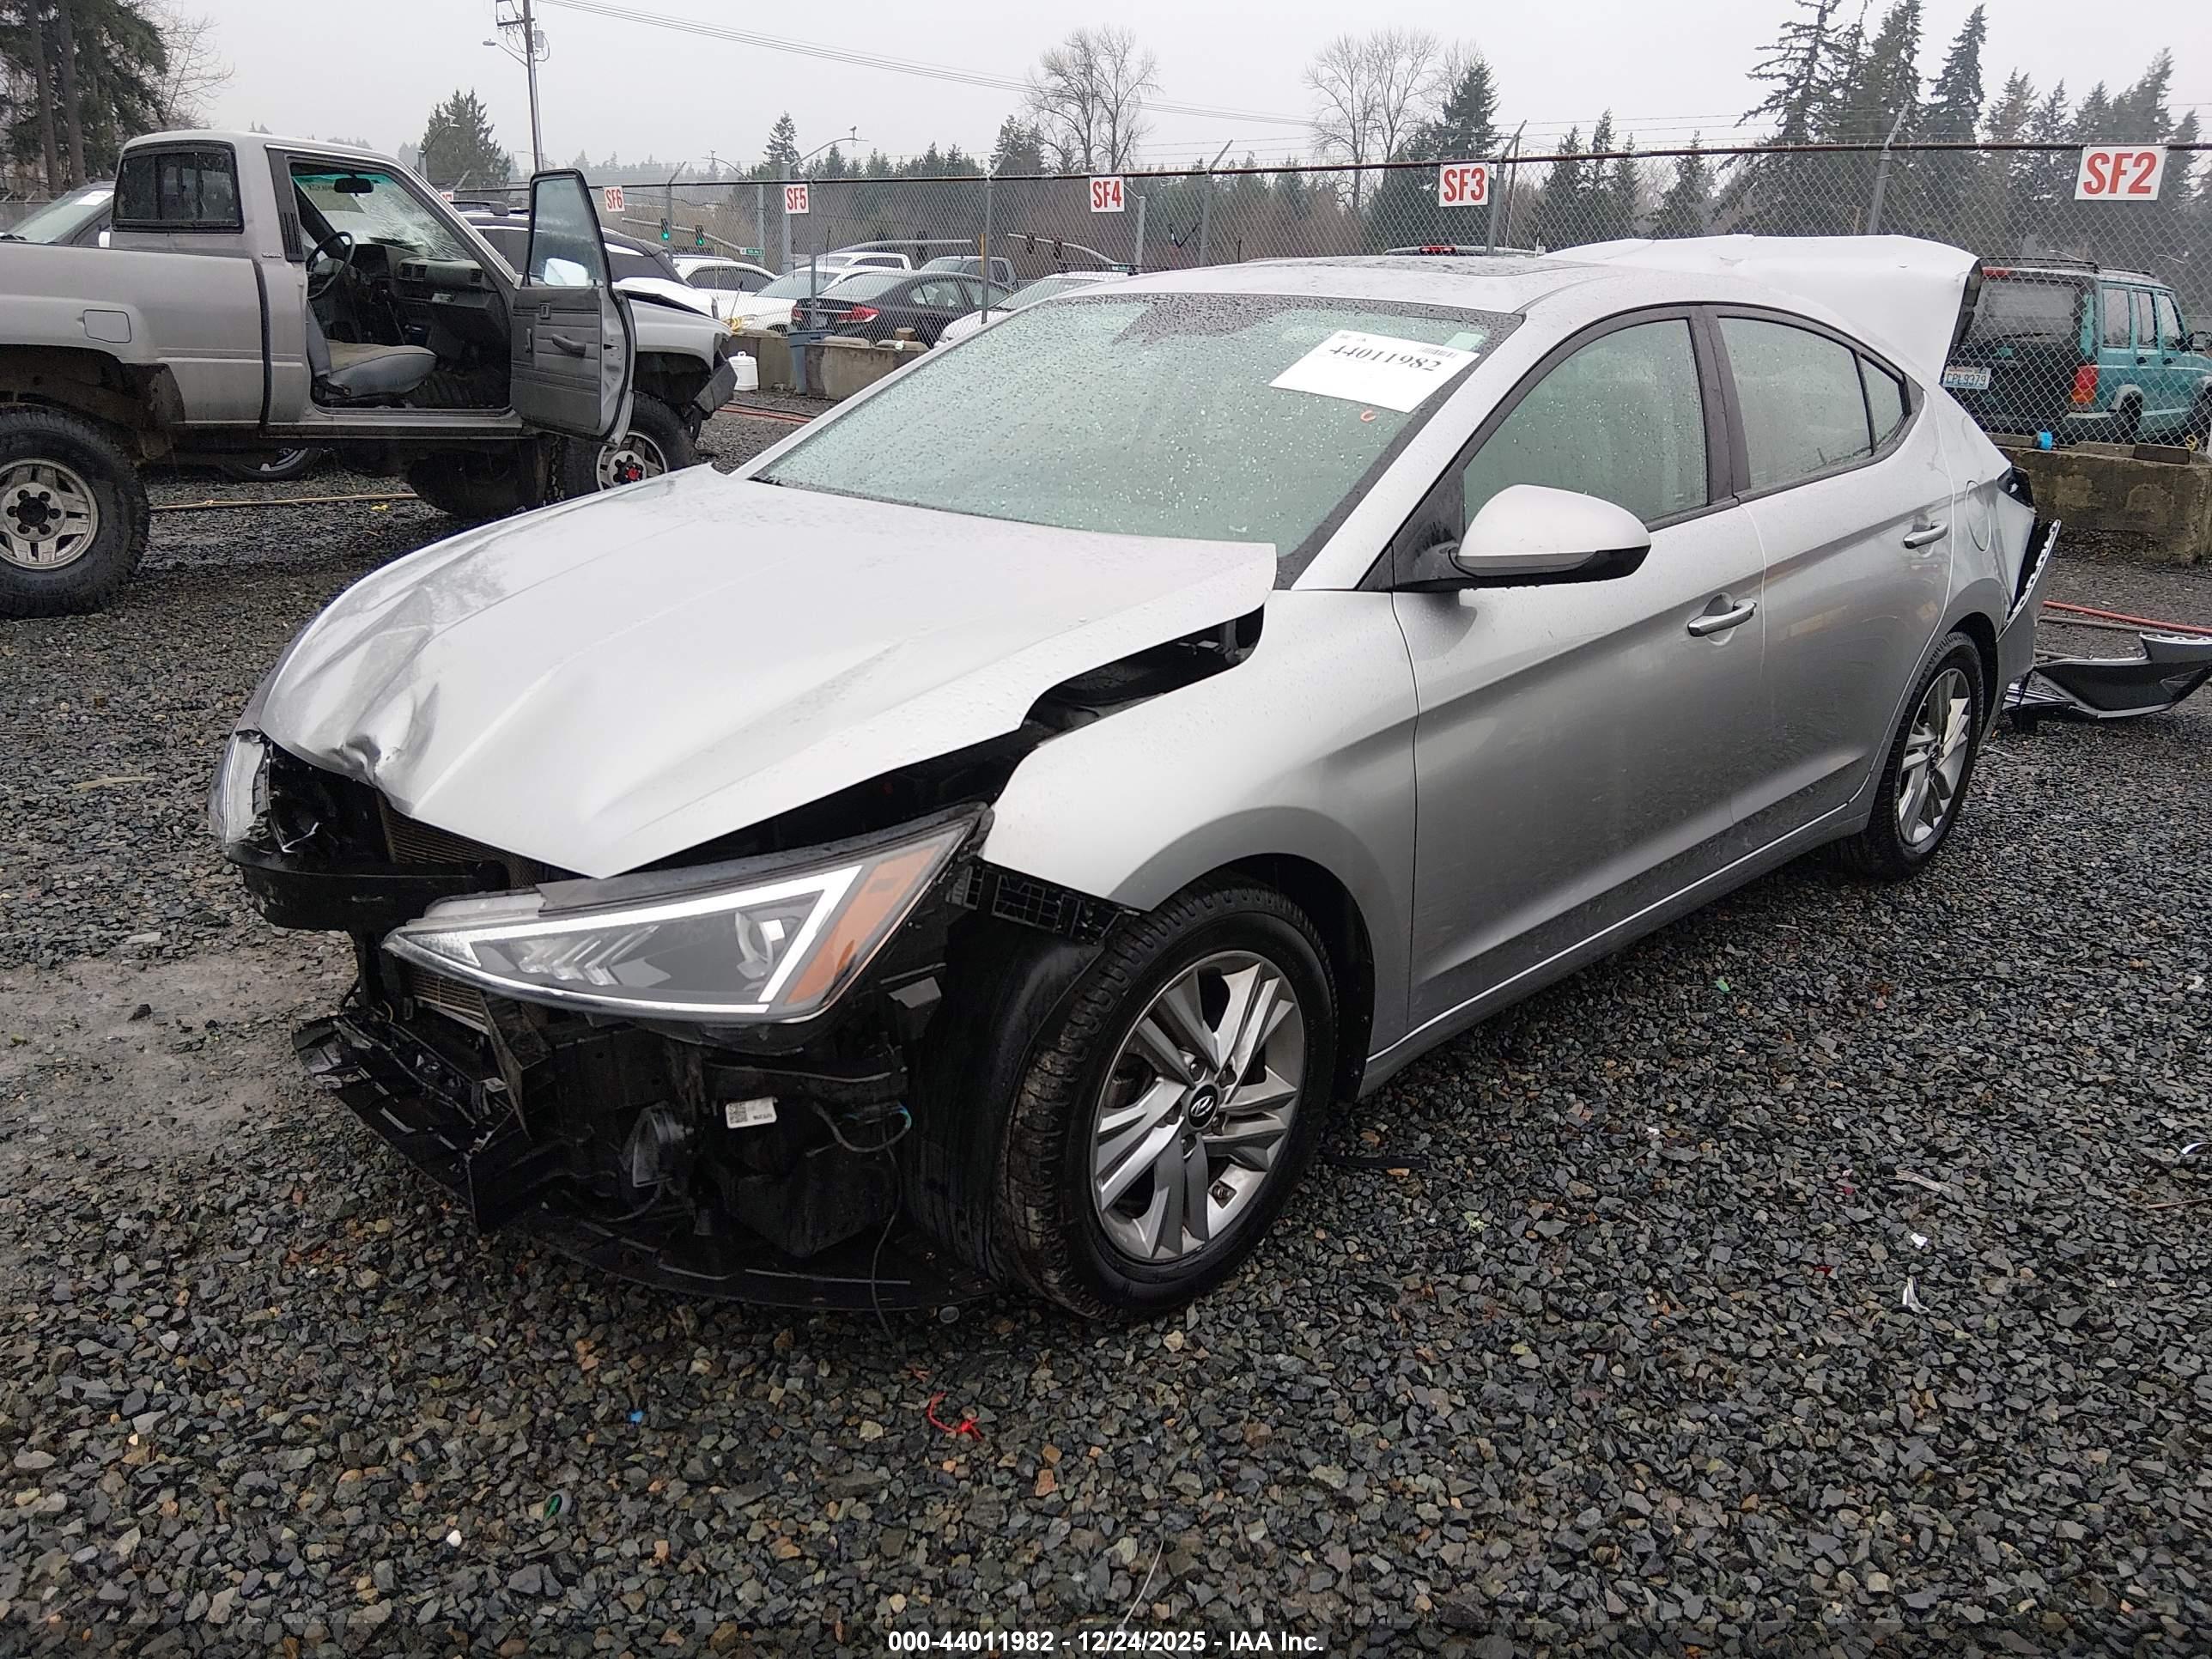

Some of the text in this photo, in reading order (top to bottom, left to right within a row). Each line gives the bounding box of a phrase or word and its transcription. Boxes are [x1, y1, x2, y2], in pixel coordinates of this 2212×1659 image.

[1443, 167, 1485, 202] SF3
[2083, 151, 2157, 195] SF2
[605, 189, 623, 209] SF6
[787, 187, 806, 210] SF5
[1093, 180, 1121, 209] SF4
[1329, 344, 1442, 372] 44011982
